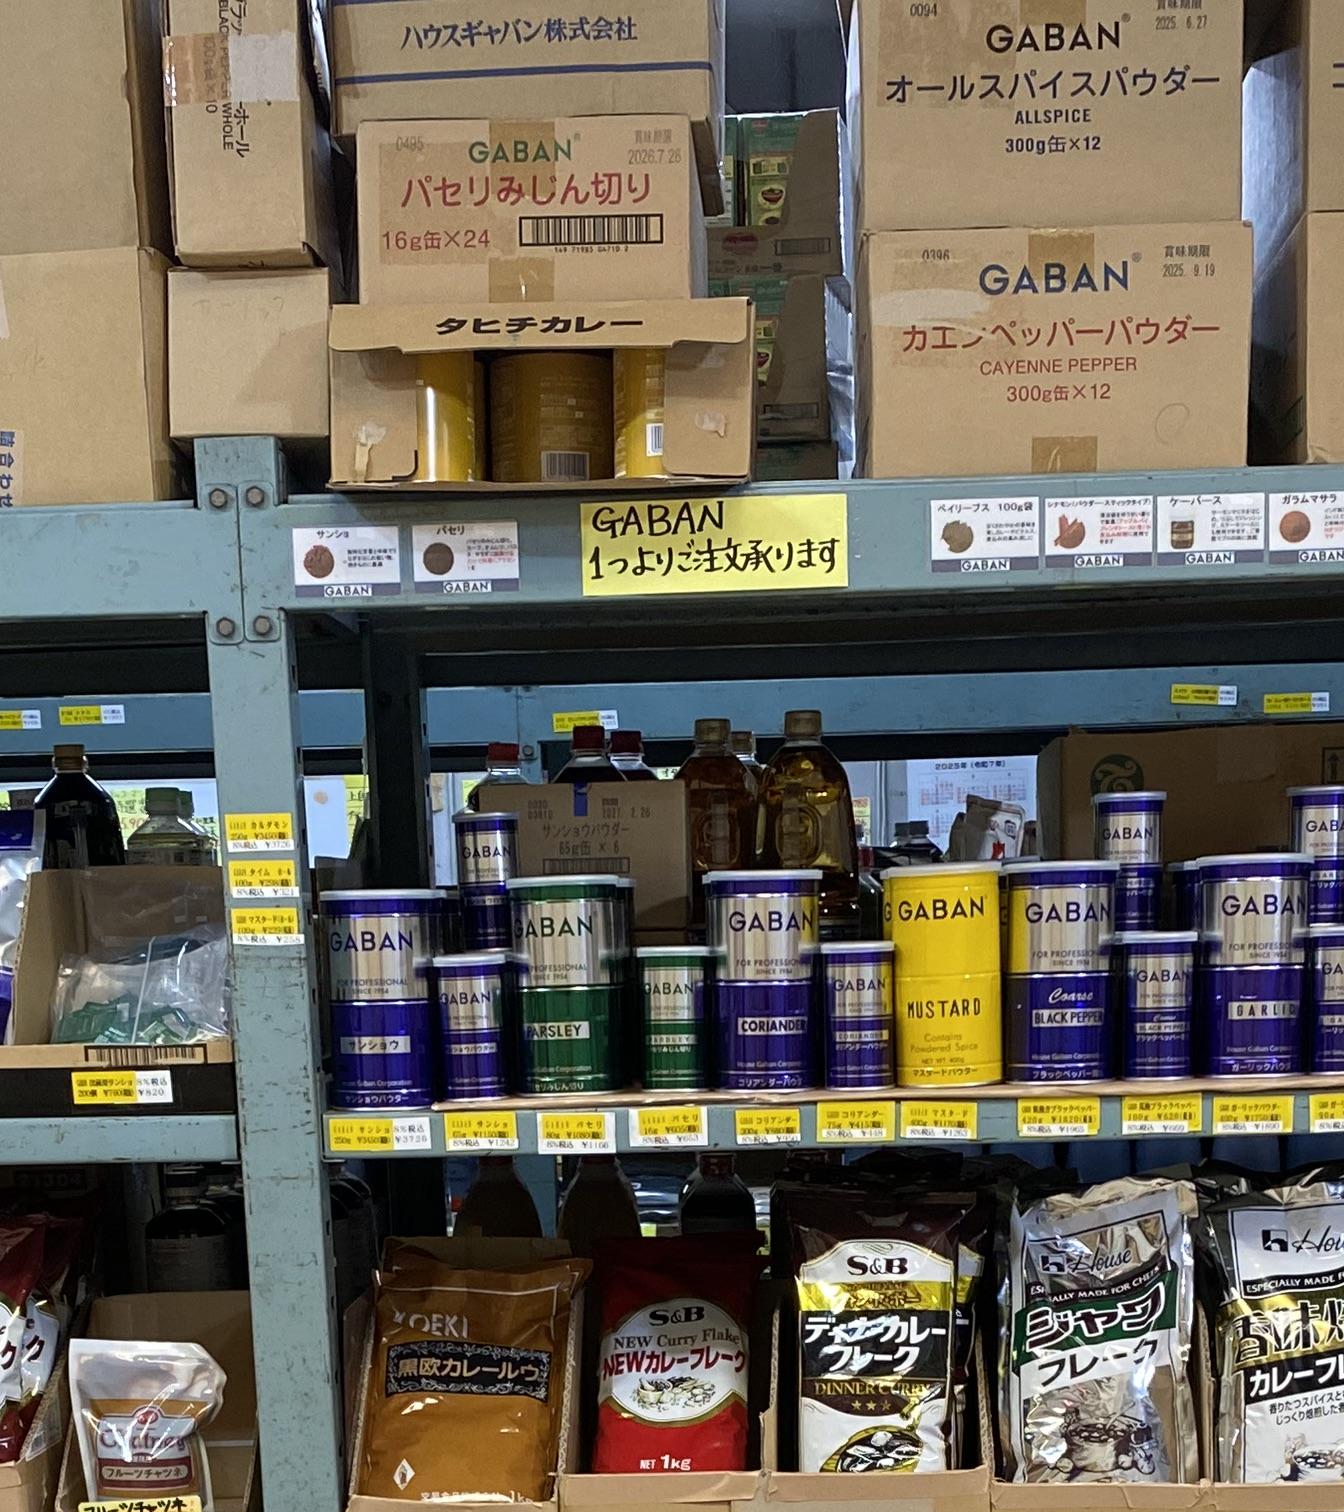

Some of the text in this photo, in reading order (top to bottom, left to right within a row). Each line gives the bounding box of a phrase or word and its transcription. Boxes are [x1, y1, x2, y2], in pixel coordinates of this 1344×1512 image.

[401, 16, 638, 50] ハウスギャバン株式会社
[985, 21, 1122, 54] GABAN
[885, 64, 1220, 104] オールスパイスパウダー
[1014, 108, 1092, 125] ALLSPICE
[468, 138, 573, 164] GABAN
[1005, 135, 1102, 155] 300g缶×12
[401, 172, 652, 208] パセリみじん切り
[381, 229, 491, 252] 16g缶×24
[978, 260, 1129, 296] GABAN
[435, 316, 644, 337] タヒチカレー
[902, 316, 1220, 353] カエンペッパーパウダー
[979, 356, 1137, 377] CAYENNE PEPPER
[1006, 382, 1112, 403] 300g缶×12
[592, 499, 726, 538] GABAN
[588, 538, 841, 587] 1つよりご注文承ります
[961, 559, 1008, 572] GABAN
[324, 584, 372, 598] GABAN
[443, 580, 490, 594] GABAN
[898, 894, 986, 922] GABAN
[1025, 900, 1112, 925] GABAN
[729, 909, 814, 933] GABAN
[330, 929, 414, 953] GABAN
[907, 998, 982, 1019] MUSTARD
[525, 1023, 583, 1039] PARSLEY
[740, 1018, 807, 1035] CORIANDER
[846, 1255, 908, 1276] S&B
[648, 1306, 705, 1326] S&B
[1027, 1284, 1163, 1352] ジャワ
[613, 1328, 741, 1350] NEW Curry Flake
[398, 1355, 541, 1383] 黒欧カレールウ
[601, 1349, 748, 1377] NEWカレーフレーク
[1038, 1338, 1159, 1388] フレーク
[660, 1454, 692, 1472] 1kg
